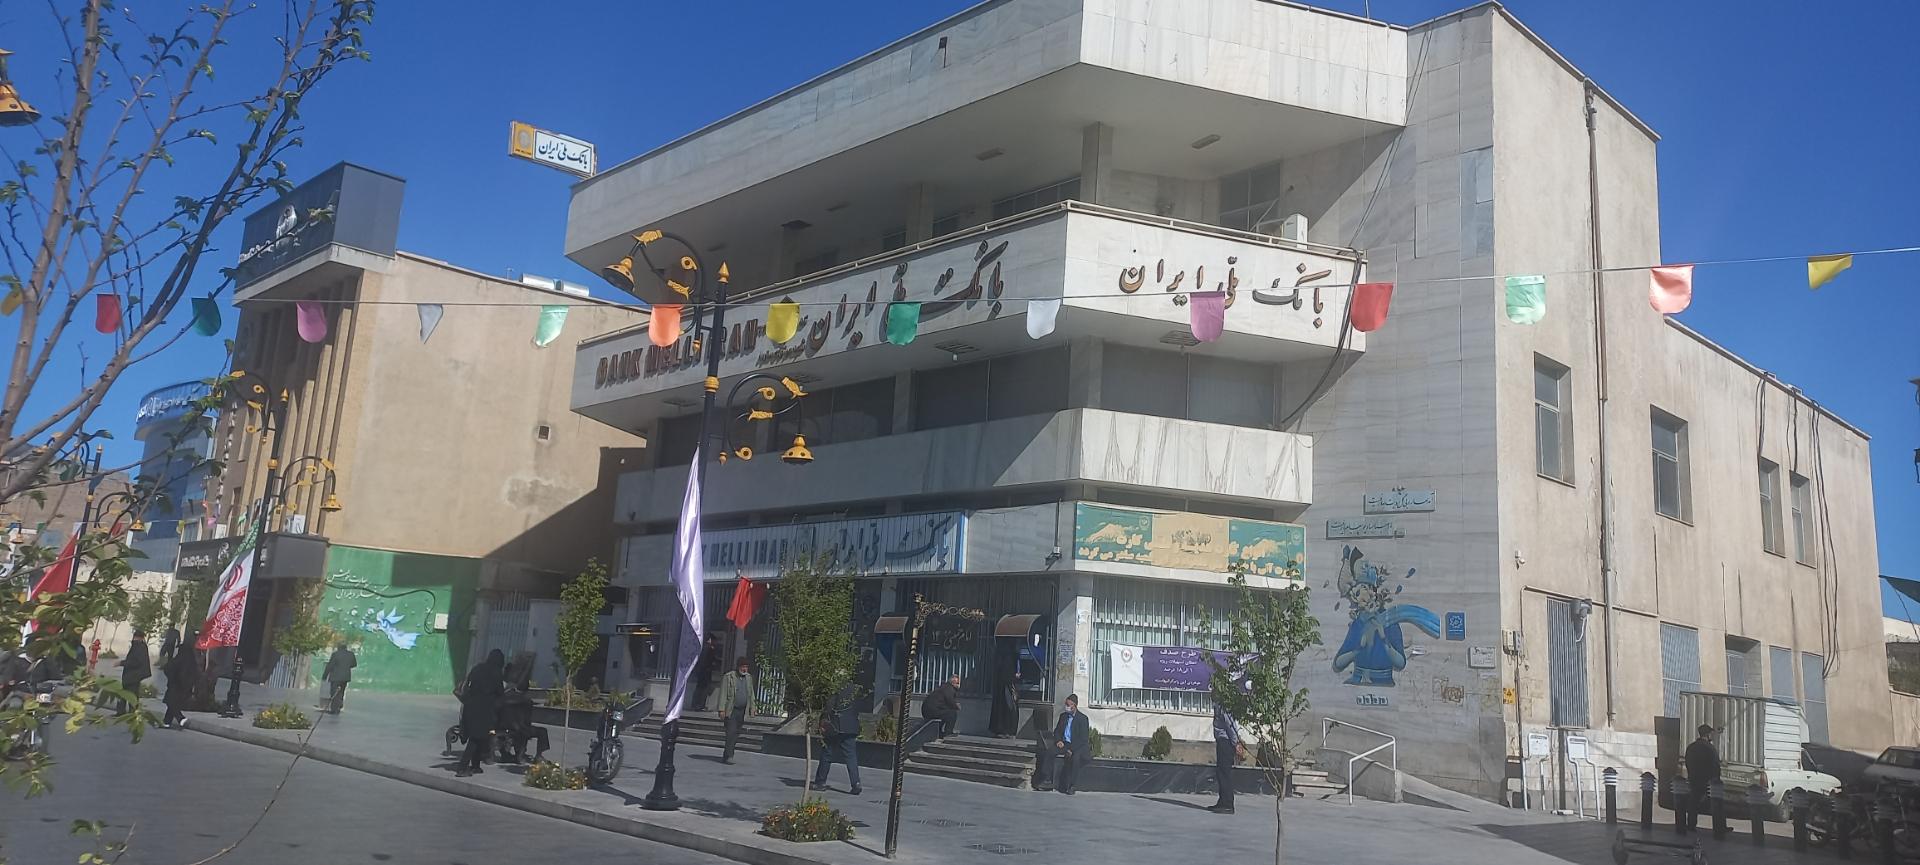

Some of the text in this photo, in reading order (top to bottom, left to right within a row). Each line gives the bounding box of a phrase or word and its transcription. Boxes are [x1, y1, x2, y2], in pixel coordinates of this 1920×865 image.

[538, 140, 559, 159] ایران
[558, 142, 567, 160] ملی
[567, 148, 589, 169] بانک
[912, 240, 1008, 320] بانک
[1119, 258, 1204, 307] ایران
[1252, 262, 1332, 328] بانک
[806, 281, 878, 356] ایران
[596, 348, 643, 389] BANK
[711, 541, 749, 567] MELLI
[885, 515, 952, 571] بانک
[1181, 650, 1197, 658] طرح
